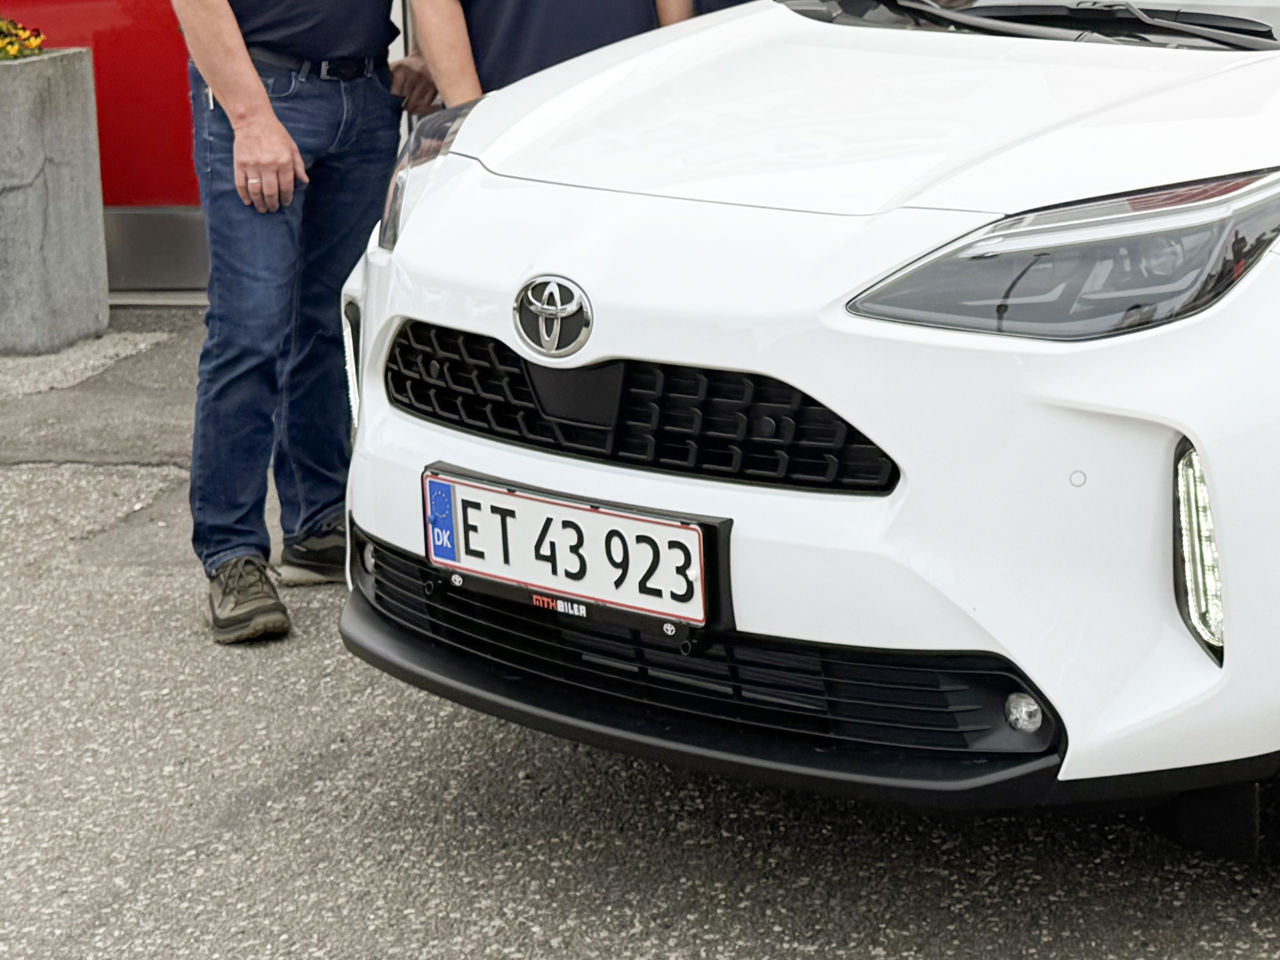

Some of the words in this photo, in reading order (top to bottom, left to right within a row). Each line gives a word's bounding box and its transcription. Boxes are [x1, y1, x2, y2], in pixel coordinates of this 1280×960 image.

[434, 527, 452, 549] DK
[461, 498, 517, 566] ET
[534, 516, 588, 582] 43
[604, 528, 696, 604] 923
